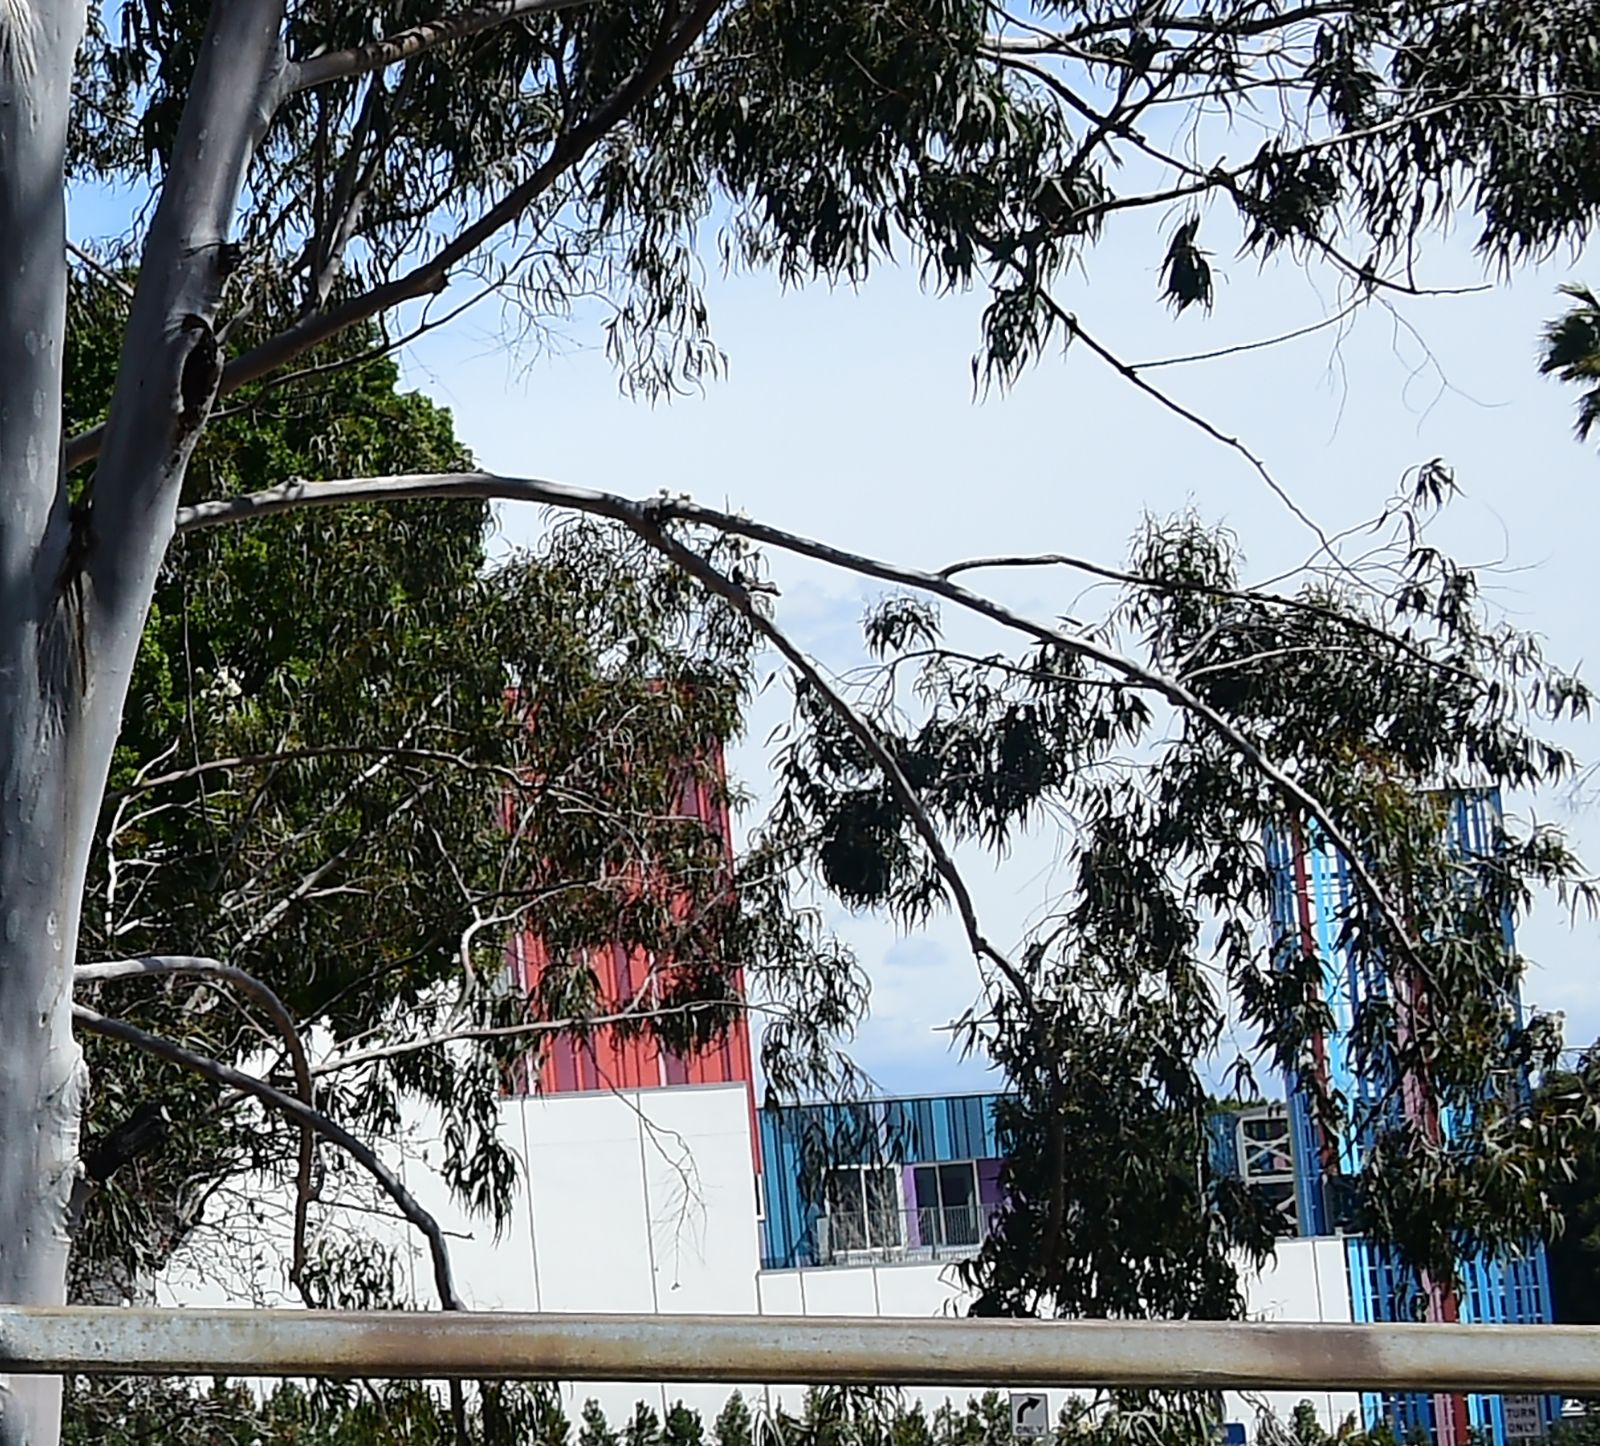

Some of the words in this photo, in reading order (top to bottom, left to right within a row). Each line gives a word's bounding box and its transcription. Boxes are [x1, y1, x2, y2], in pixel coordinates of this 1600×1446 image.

[1506, 1408, 1536, 1418] TURN
[1016, 1425, 1044, 1434] ONLY
[1508, 1423, 1536, 1433] ONLY
